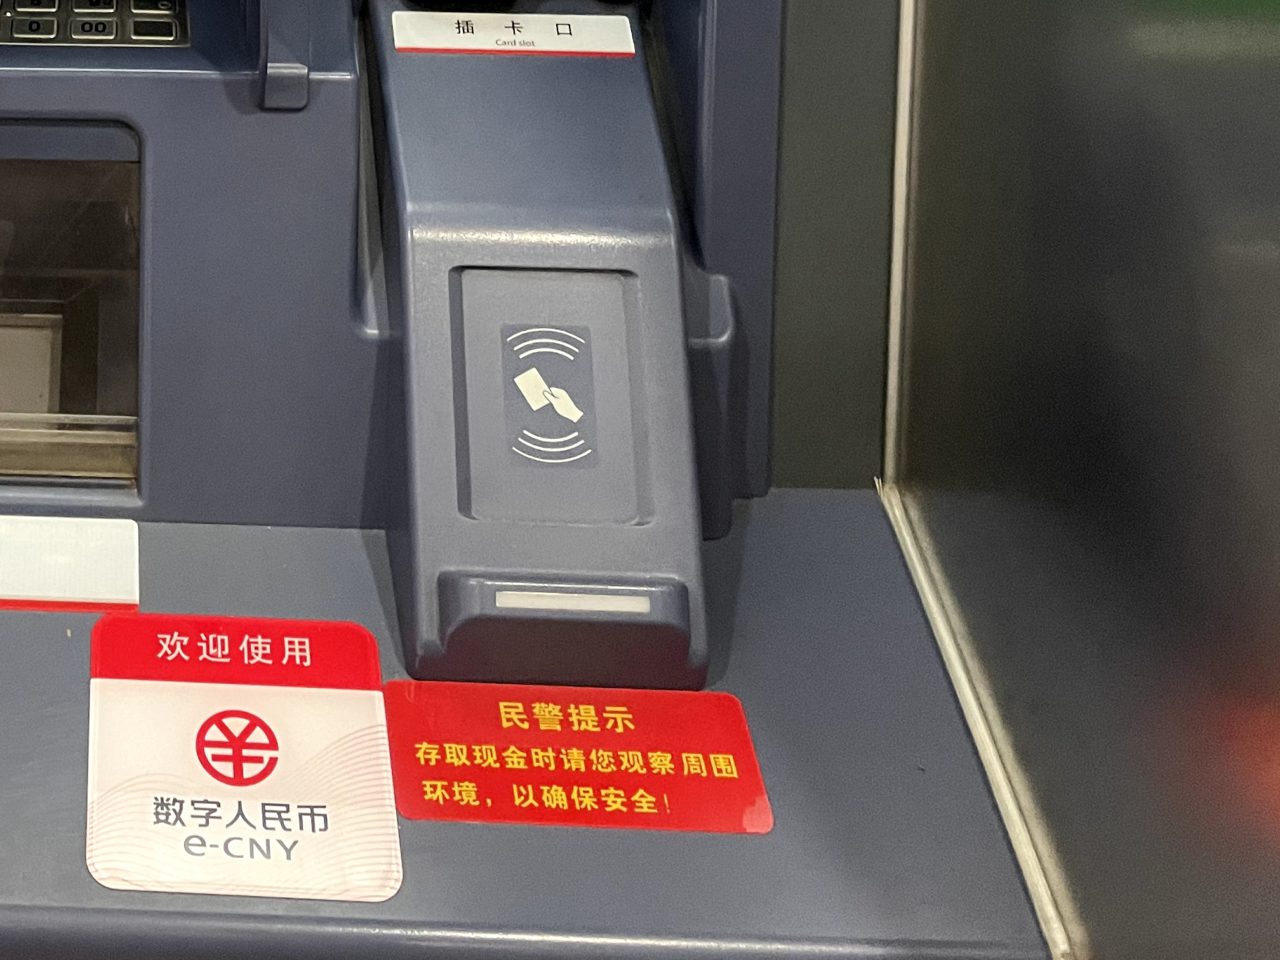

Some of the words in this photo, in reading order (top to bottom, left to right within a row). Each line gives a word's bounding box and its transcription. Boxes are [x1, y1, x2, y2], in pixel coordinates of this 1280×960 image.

[29, 21, 41, 32] 0
[81, 21, 107, 33] 00
[455, 18, 574, 37] 插卡口
[495, 37, 516, 48] Card
[517, 37, 536, 48] slot
[156, 631, 312, 667] 欢迎使用
[498, 701, 636, 734] 民警提示
[152, 795, 329, 834] 数字人民币
[183, 833, 300, 862] e-CNY
